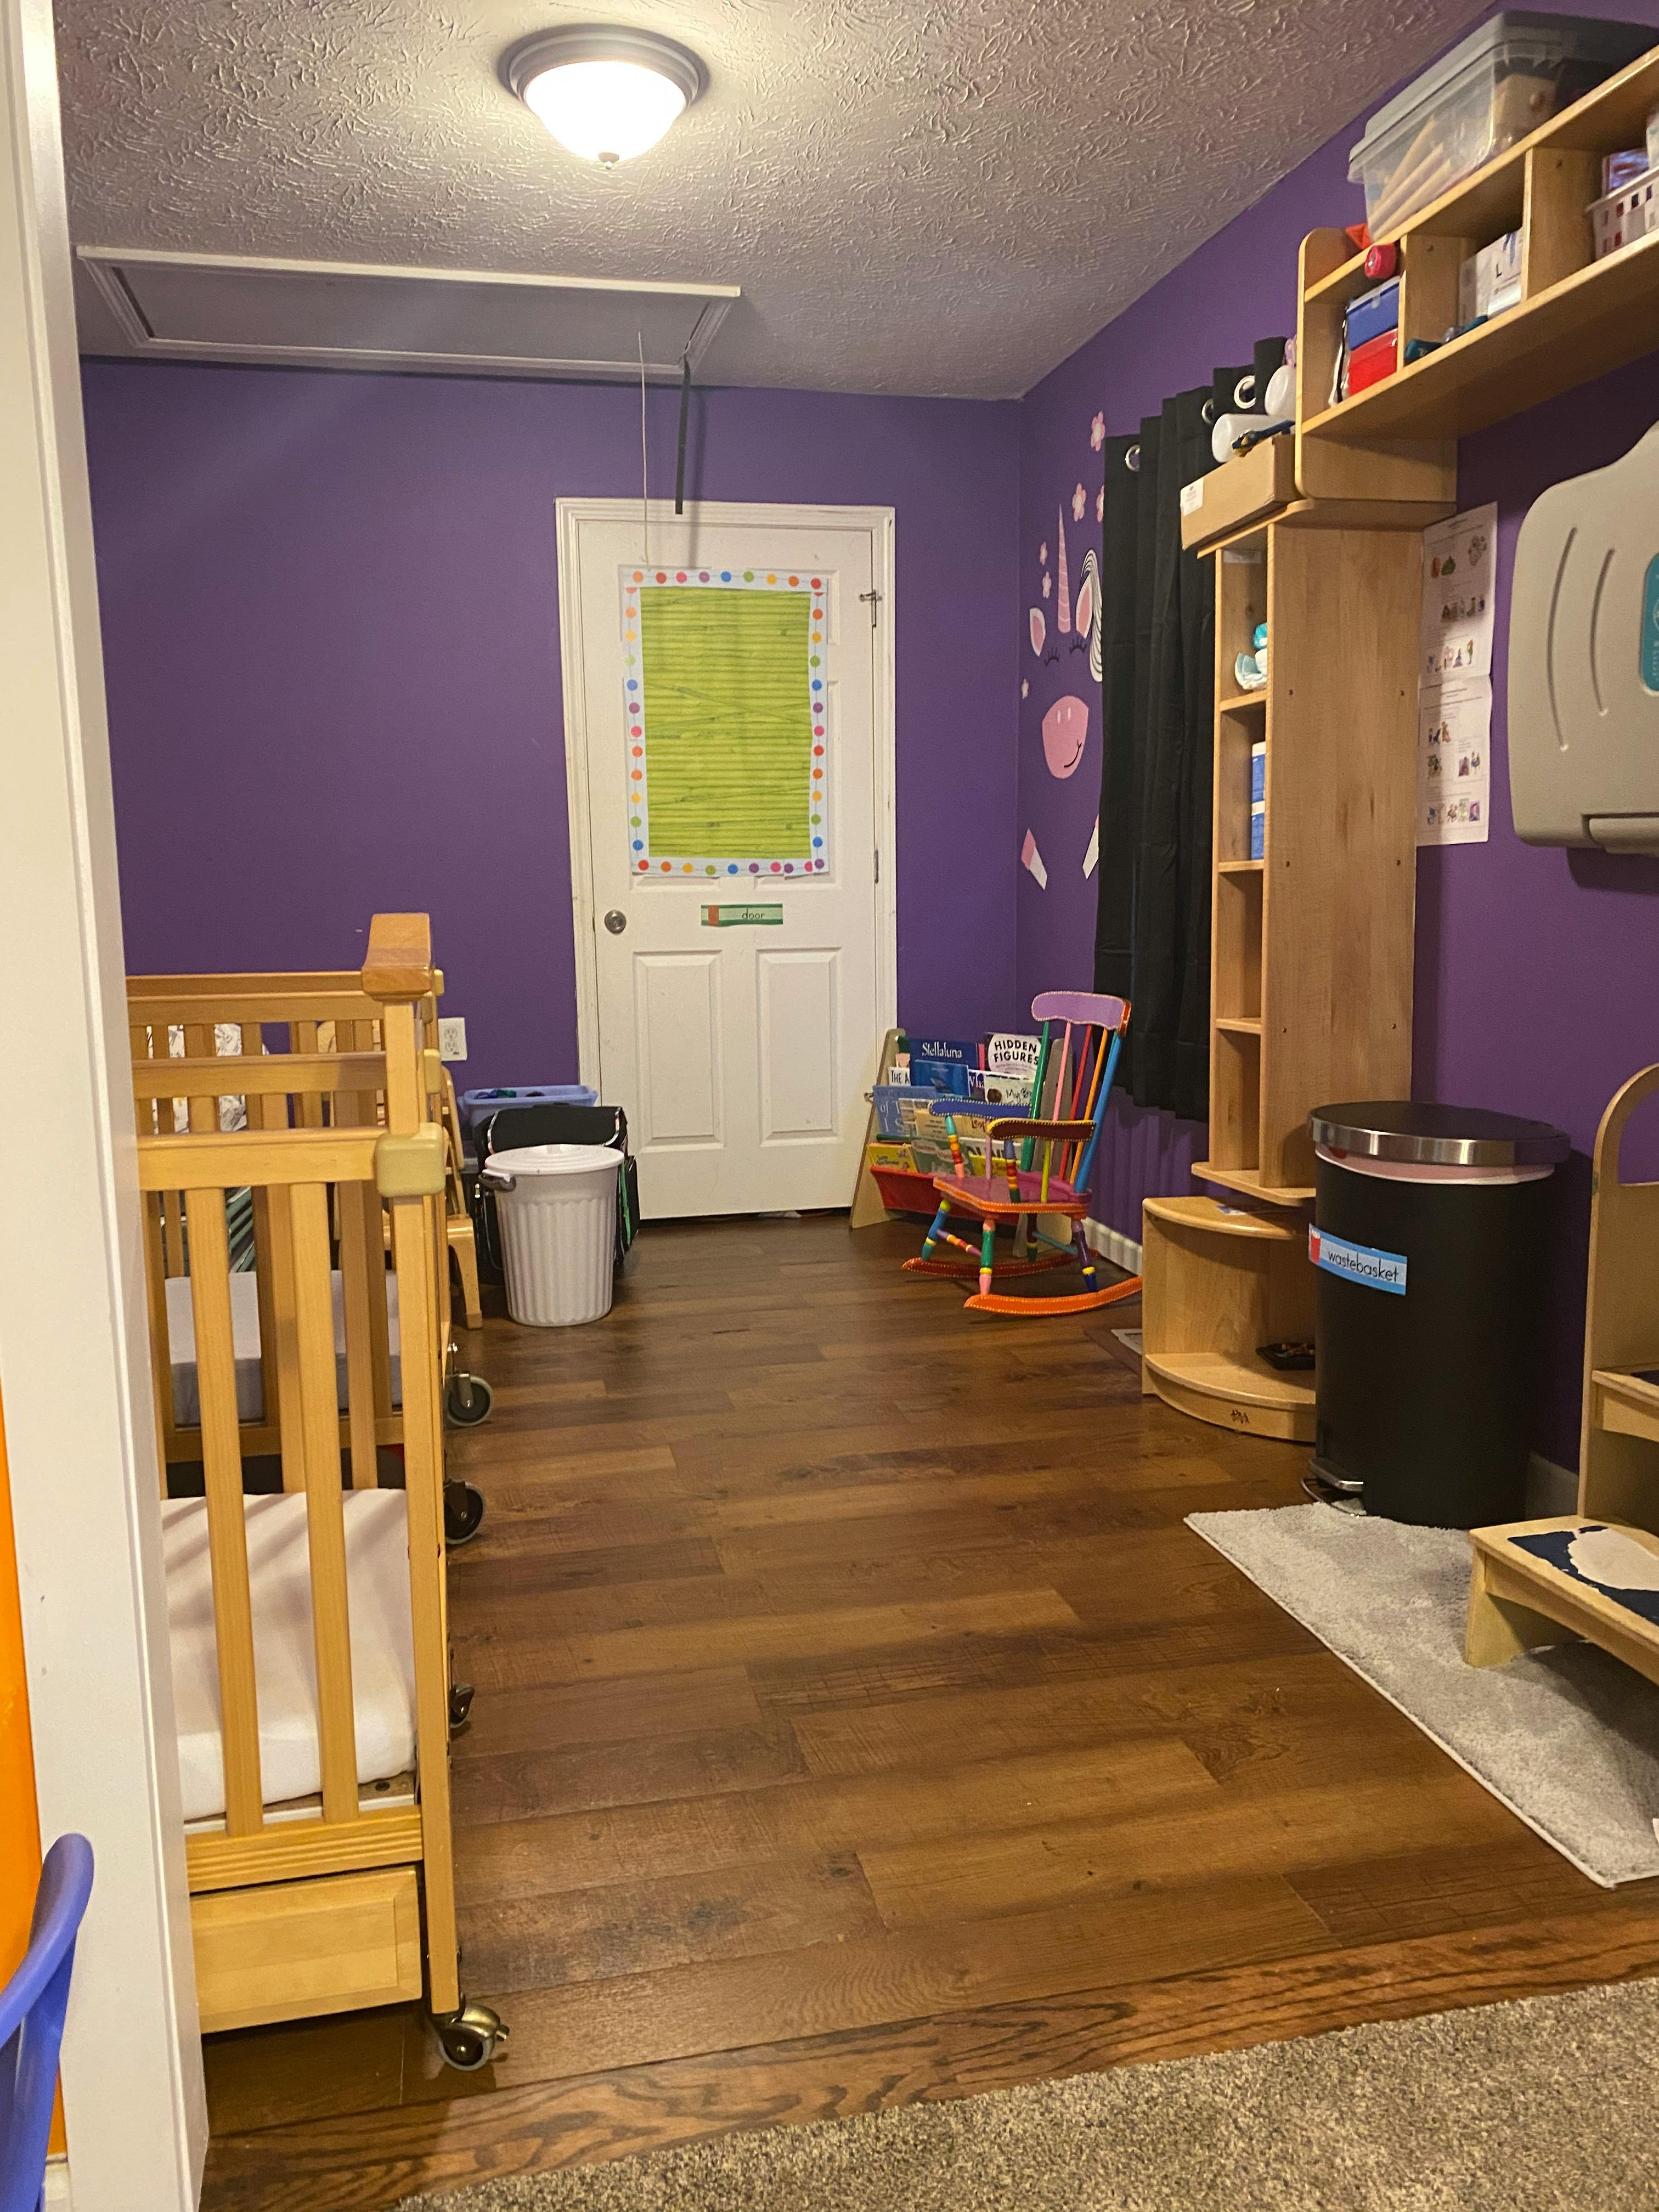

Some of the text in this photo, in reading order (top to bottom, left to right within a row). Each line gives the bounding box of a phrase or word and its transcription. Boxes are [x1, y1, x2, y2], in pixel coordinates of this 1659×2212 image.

[742, 908, 765, 919] door
[922, 1041, 962, 1058] Stellaluna
[995, 1039, 1037, 1054] HIDDEN
[994, 1051, 1039, 1065] FIGURES
[891, 1070, 901, 1083] THE
[1328, 1250, 1400, 1283] wastebasket
